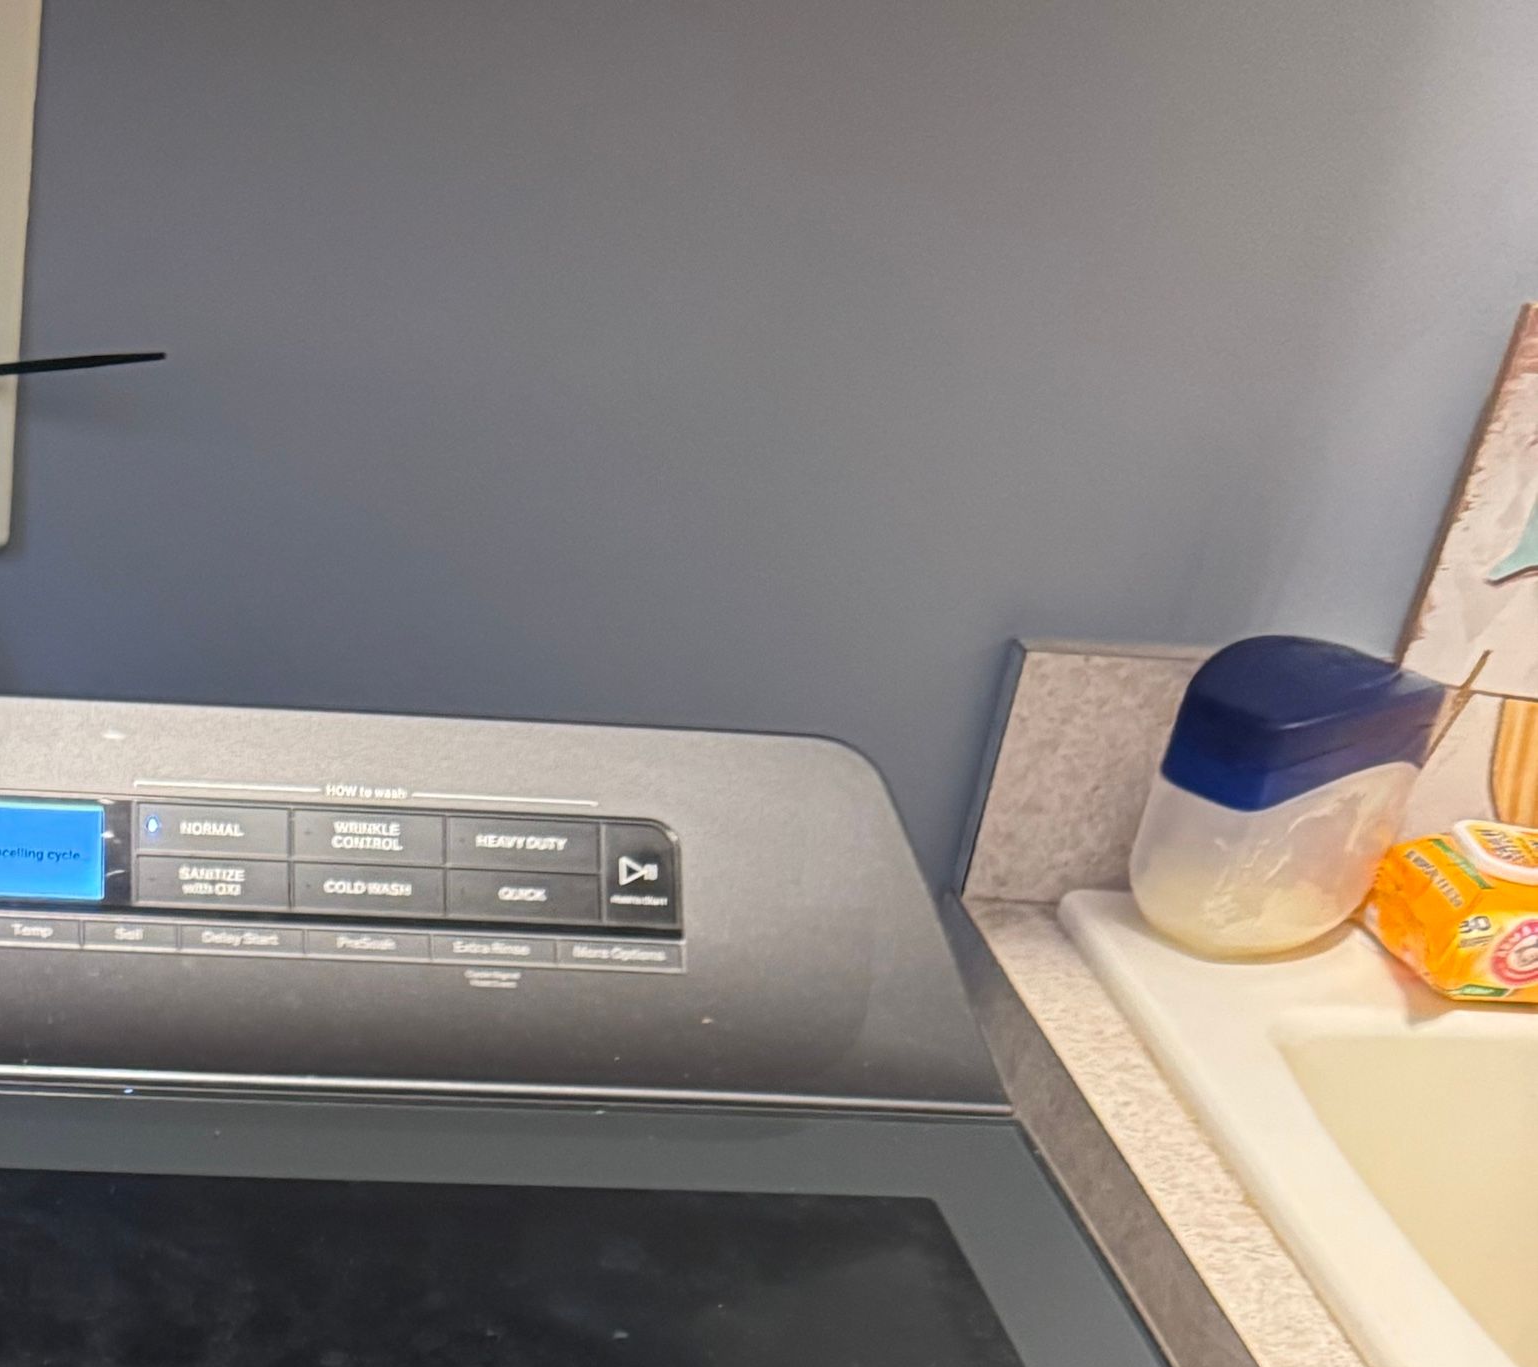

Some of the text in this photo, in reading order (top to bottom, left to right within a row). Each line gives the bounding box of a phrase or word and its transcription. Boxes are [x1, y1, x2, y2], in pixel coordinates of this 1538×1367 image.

[325, 784, 408, 800] HOW to wash
[179, 821, 244, 837] NORMAL
[333, 820, 401, 836] WRINKLE
[330, 835, 404, 851] CONTROL
[475, 834, 568, 851] HEAVY DUTY
[178, 866, 246, 882] SANITIZE
[182, 882, 214, 896] with
[323, 879, 412, 897] COLD WASH
[497, 886, 548, 902] QUICK
[12, 923, 53, 939] Temp
